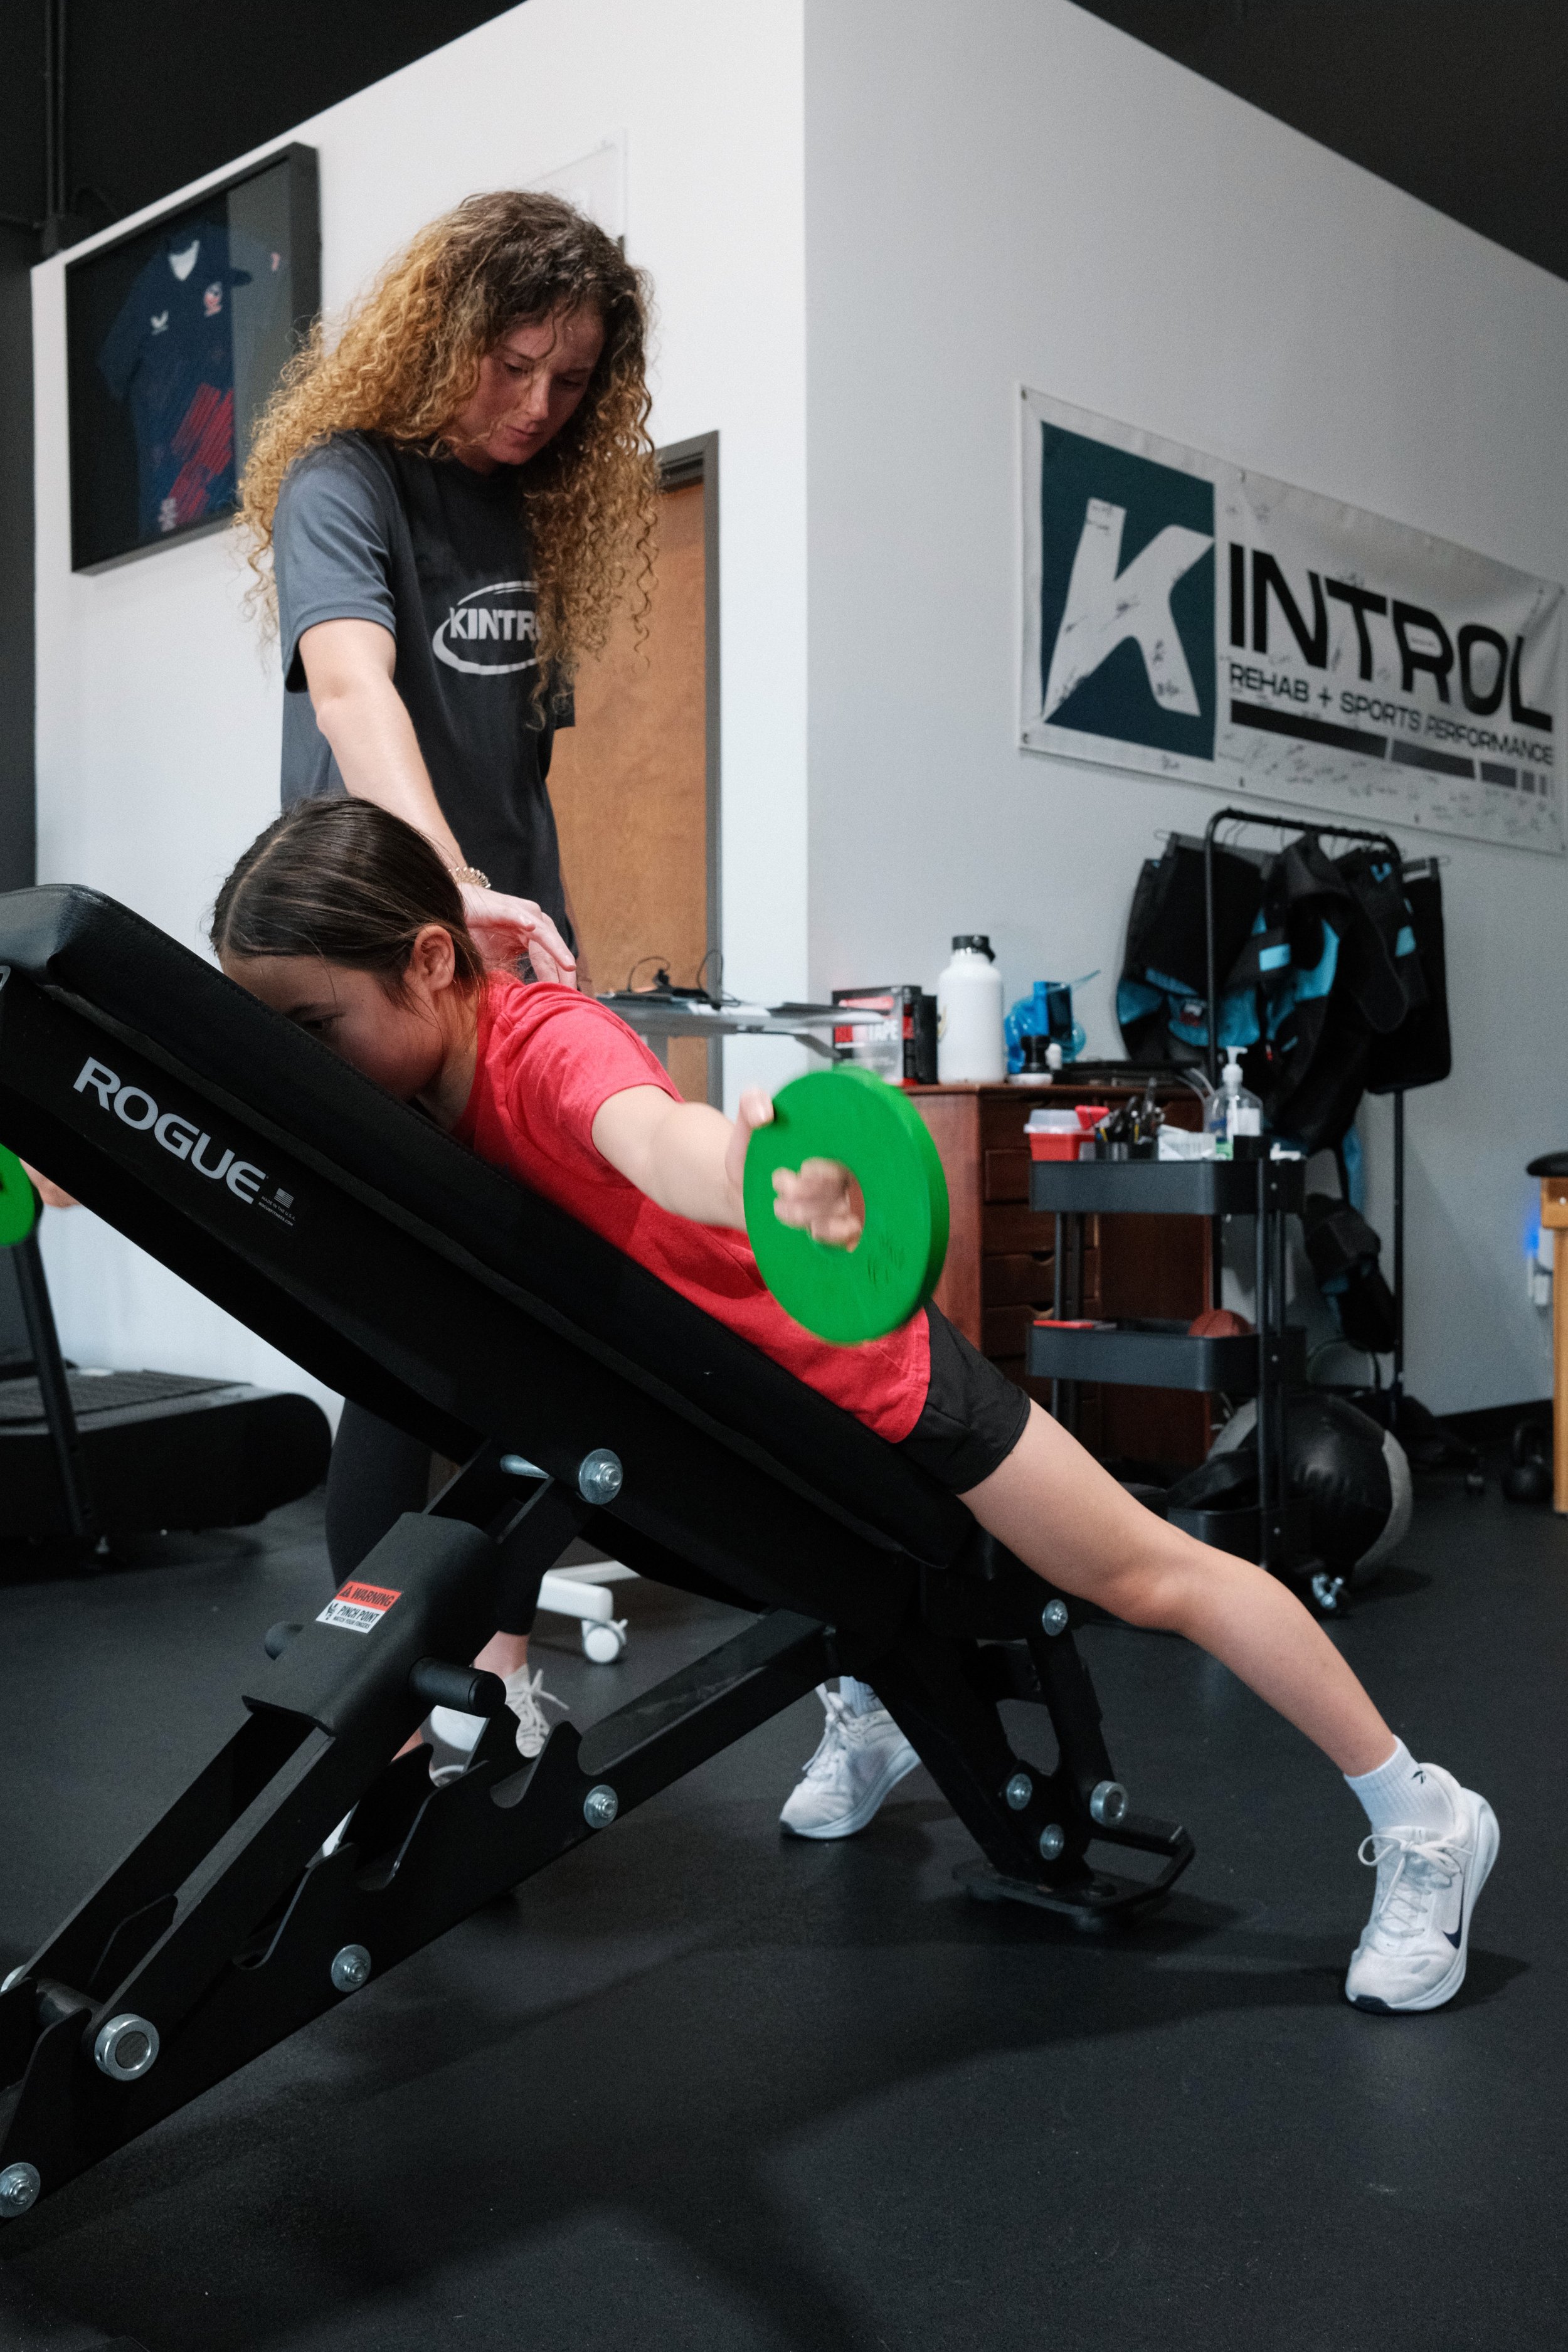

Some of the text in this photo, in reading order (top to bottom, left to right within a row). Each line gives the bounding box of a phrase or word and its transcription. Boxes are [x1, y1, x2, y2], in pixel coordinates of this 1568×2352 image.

[1230, 662, 1309, 703] REHAB
[1340, 691, 1421, 731] SPORTS
[1425, 713, 1554, 766] PERFORMANCE
[73, 1056, 267, 1204] ROGUE
[262, 1196, 273, 1205] MADE
[352, 1587, 395, 1607] WARNING
[337, 1606, 379, 1623] PINCH POINT
